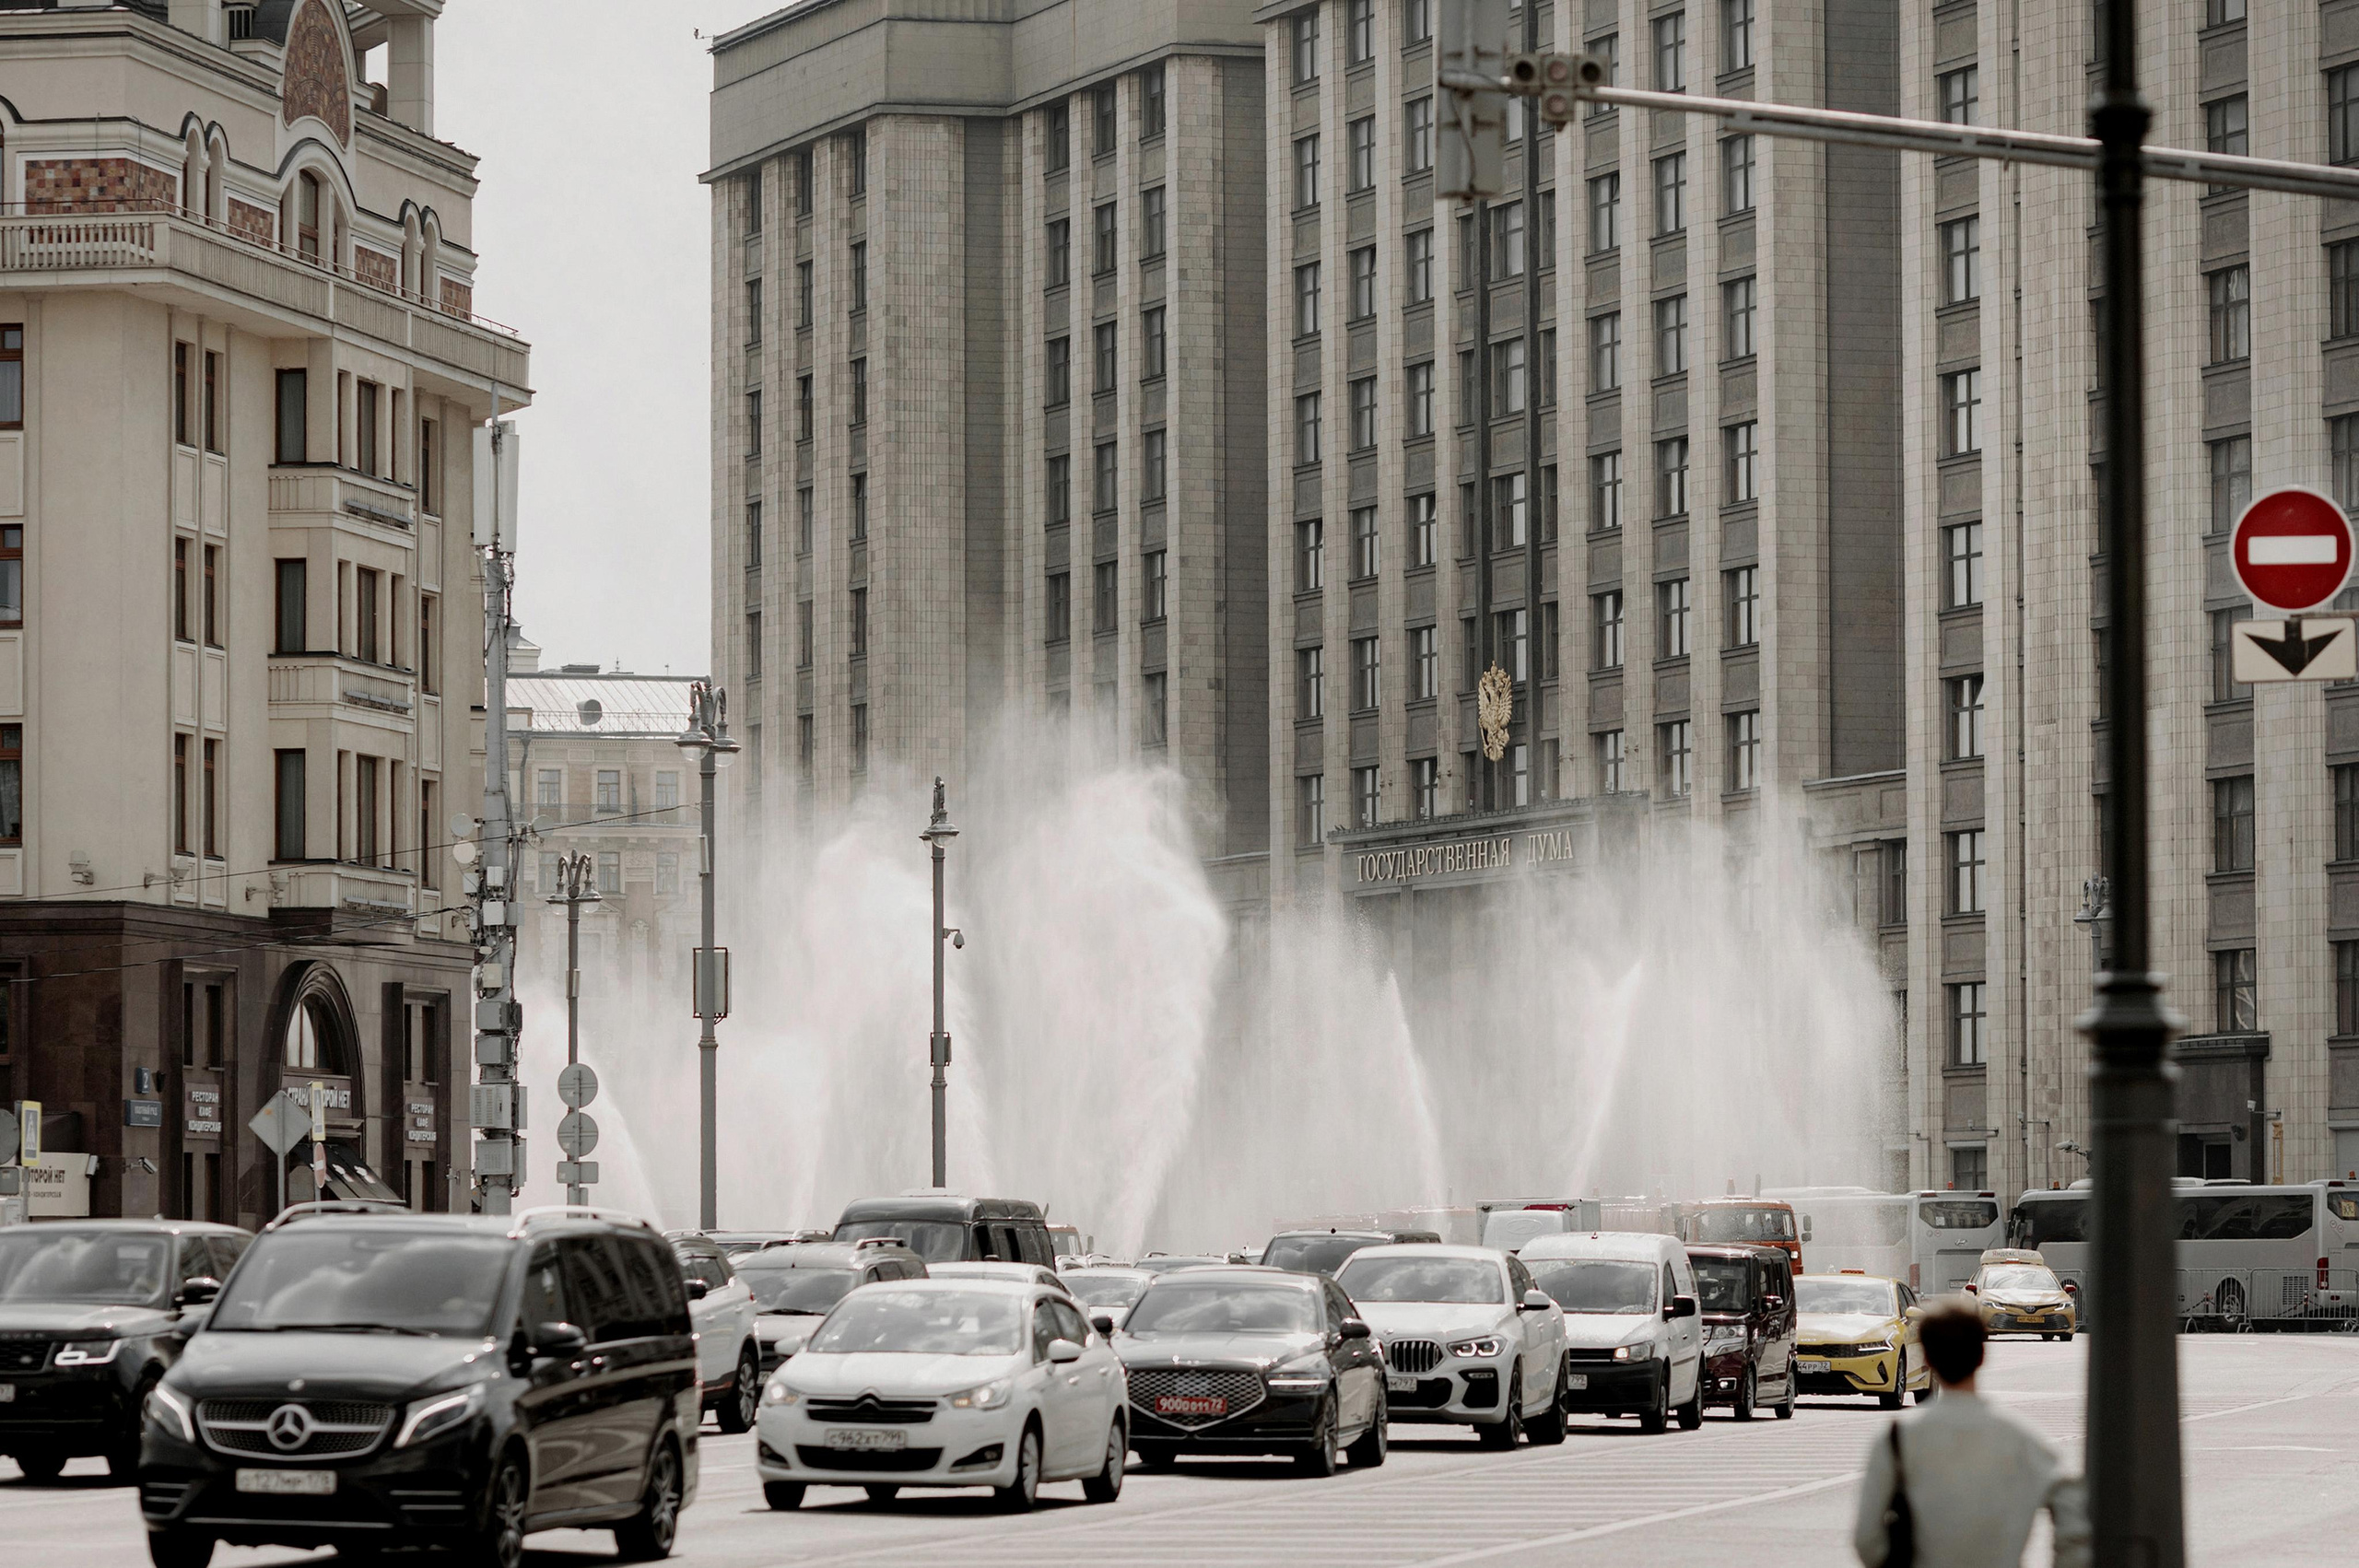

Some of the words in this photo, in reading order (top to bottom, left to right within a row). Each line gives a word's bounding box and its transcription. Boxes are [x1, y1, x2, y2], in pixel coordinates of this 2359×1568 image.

[1357, 837, 1511, 883] ГОСУДАРСТВЕННАЯ
[1526, 830, 1574, 867] ДУМА
[143, 1072, 148, 1088] 2
[192, 1091, 219, 1104] РЕСТОРАН
[338, 1090, 351, 1108] НЕТ
[198, 1106, 212, 1117] КАФЕ
[411, 1103, 434, 1115] РЕСТОРАН
[417, 1117, 428, 1128] КАФЕ
[53, 1169, 65, 1184] НЕТ
